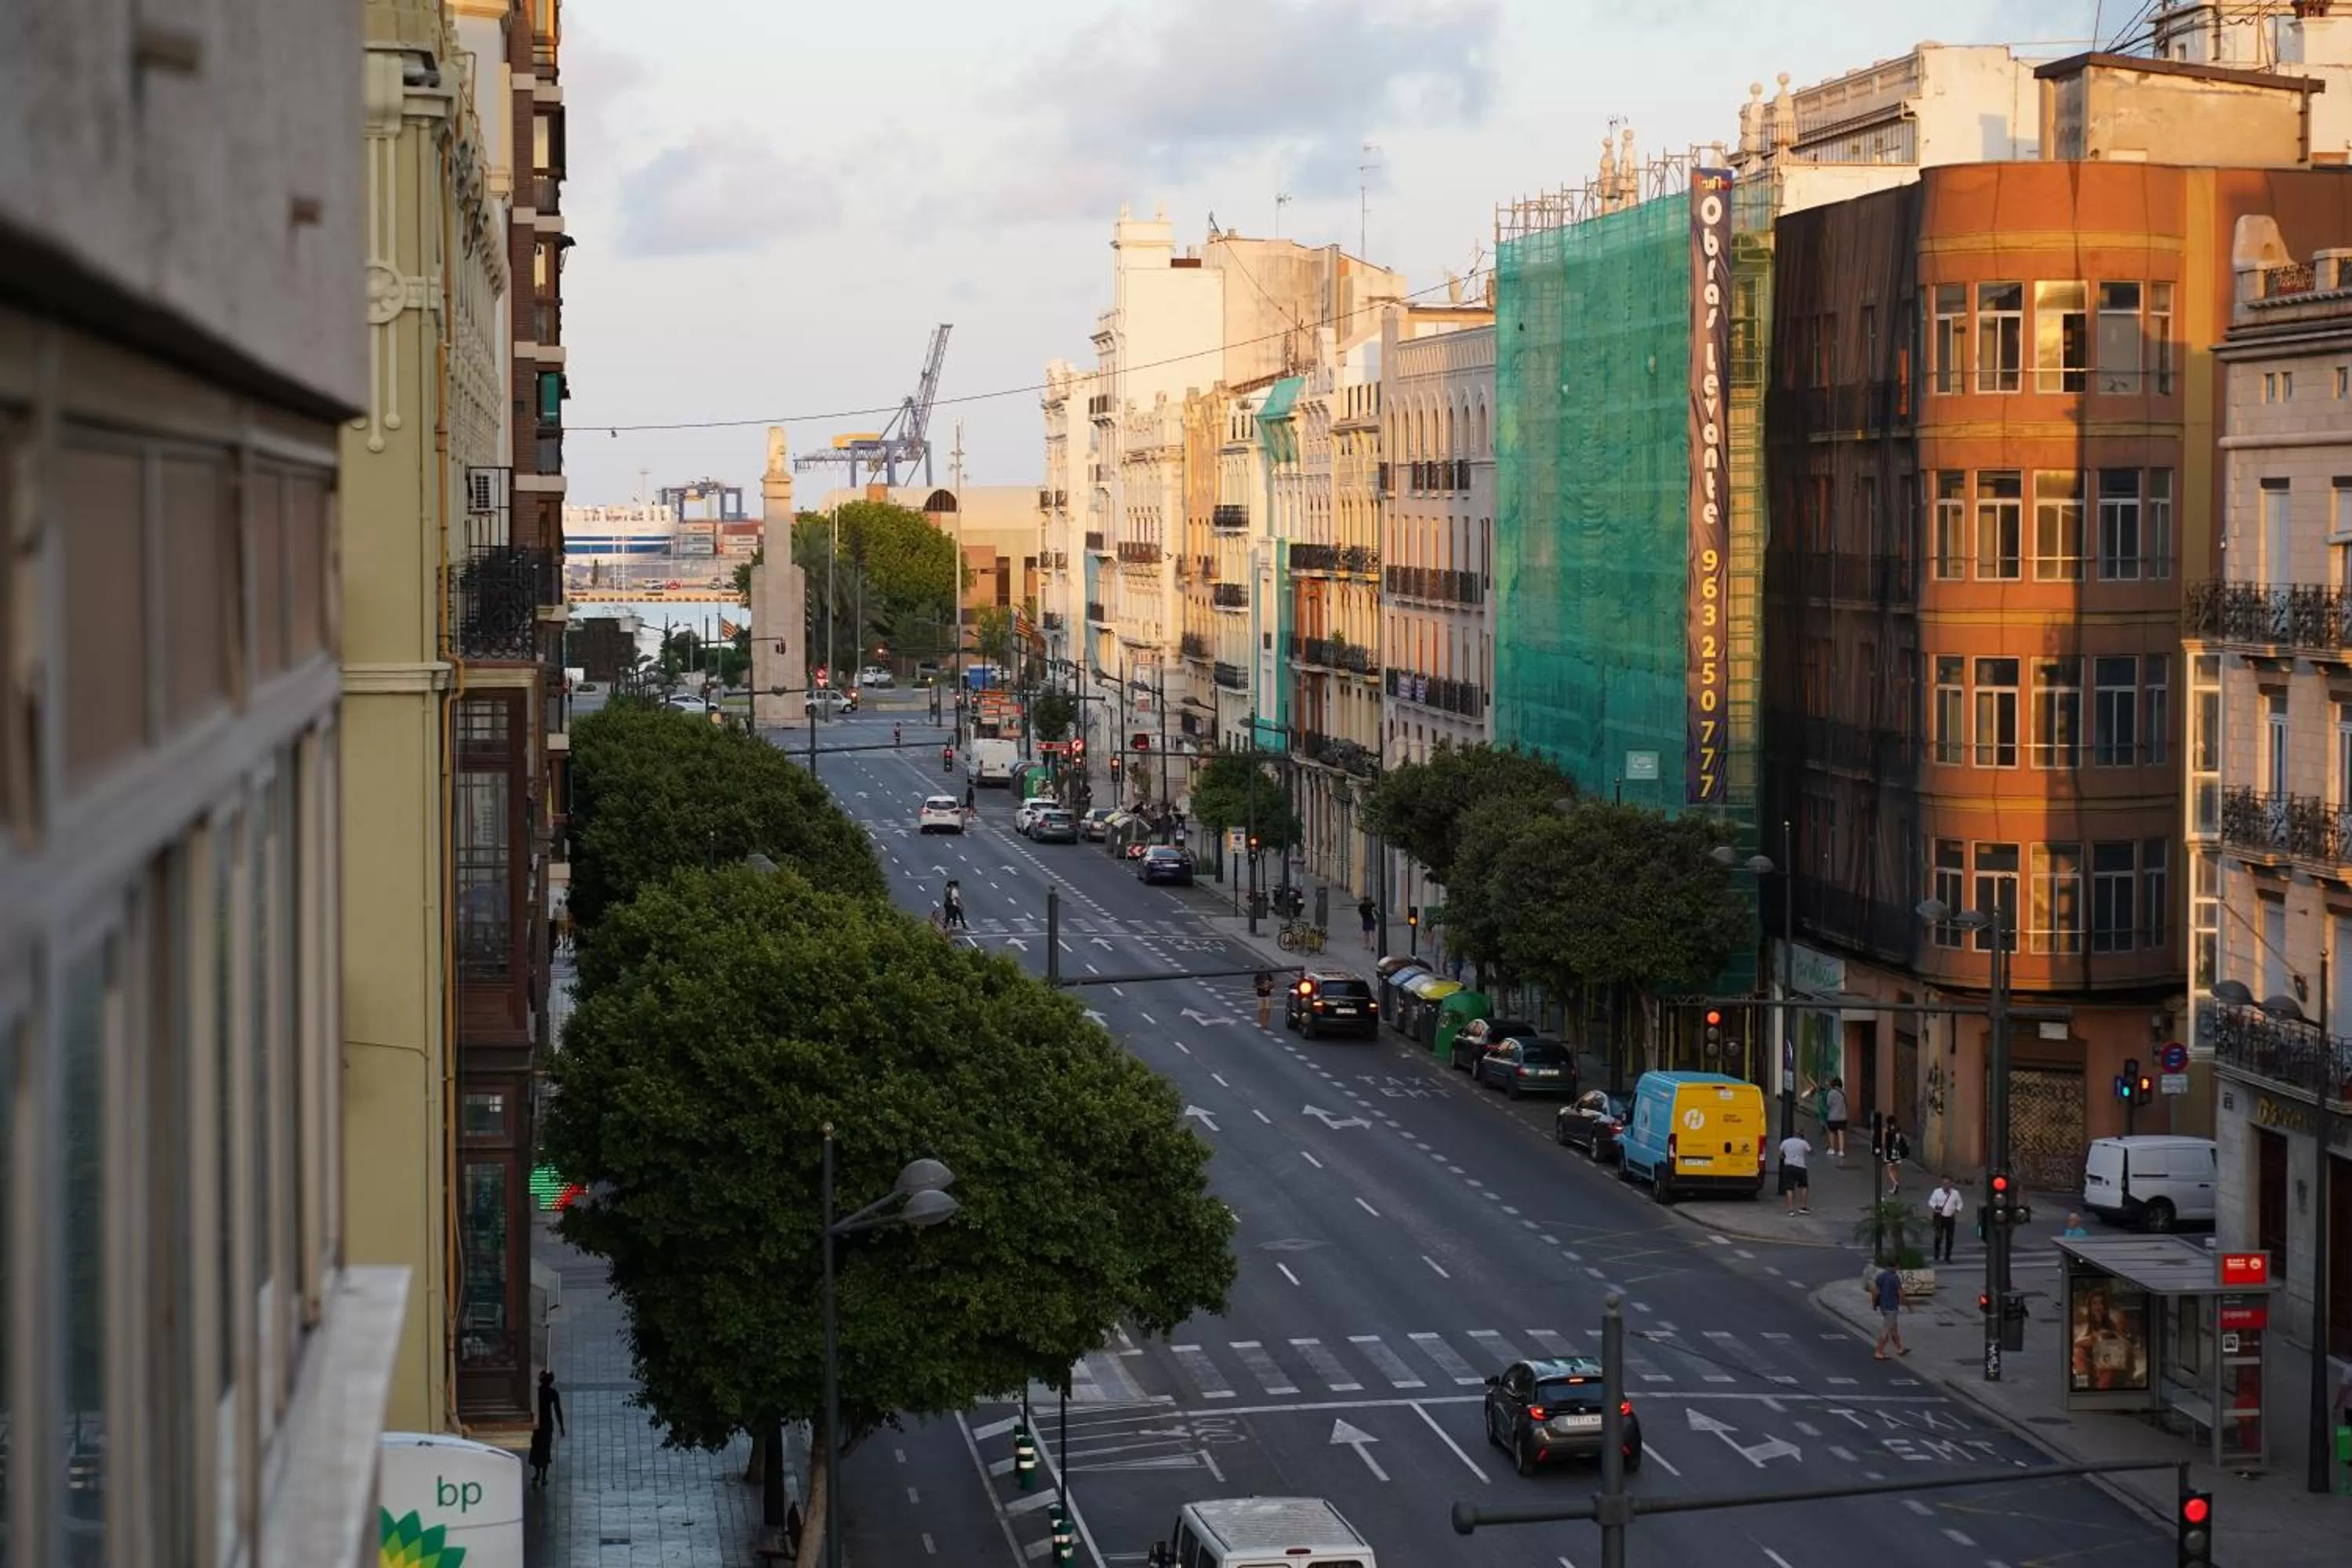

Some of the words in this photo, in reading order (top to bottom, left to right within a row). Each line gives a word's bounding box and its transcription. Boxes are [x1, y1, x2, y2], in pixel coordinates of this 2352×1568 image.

[1701, 195, 1722, 329] Obras
[1828, 1409, 1971, 1431] TAXI
[1882, 1439, 1996, 1461] EMT
[437, 1475, 483, 1513] bp
